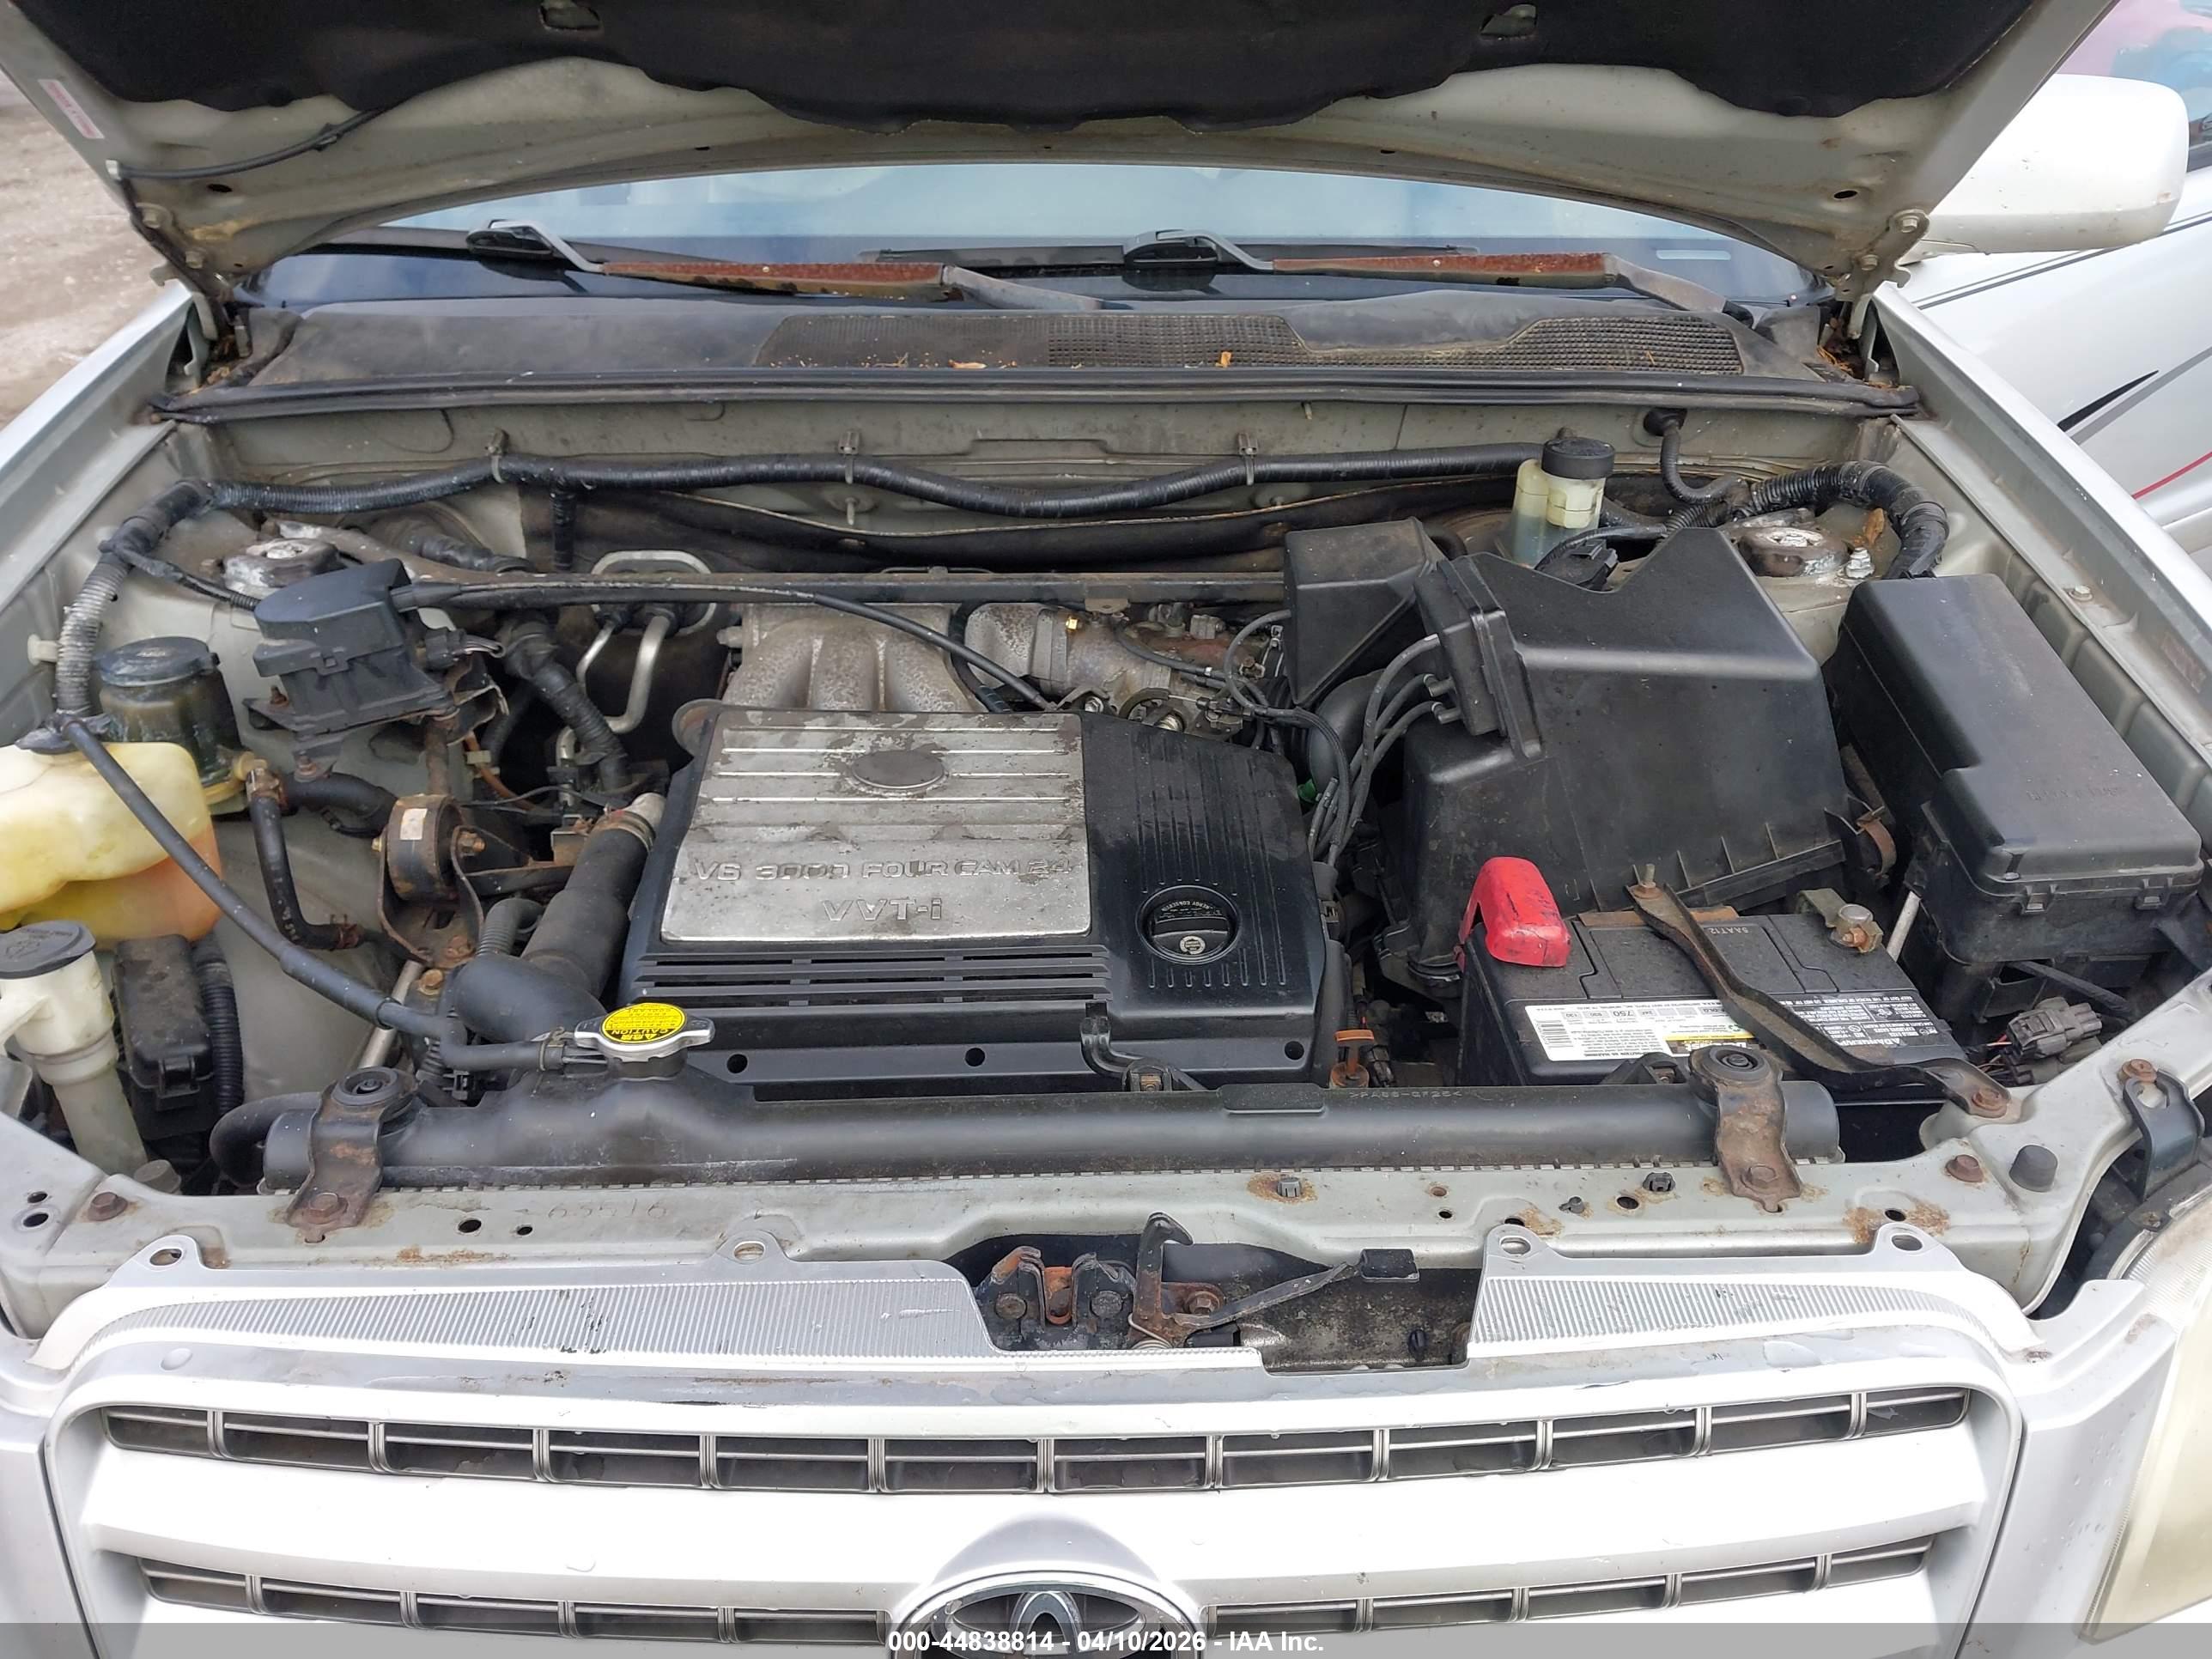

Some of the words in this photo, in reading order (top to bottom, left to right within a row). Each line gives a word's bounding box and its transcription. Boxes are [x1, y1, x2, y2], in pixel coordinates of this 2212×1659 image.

[694, 860, 741, 881] V6
[755, 862, 850, 881] 3000
[861, 860, 949, 878] FOUR
[957, 858, 1020, 878] CAM
[1025, 857, 1073, 878] 24
[821, 897, 945, 921] VVT-i
